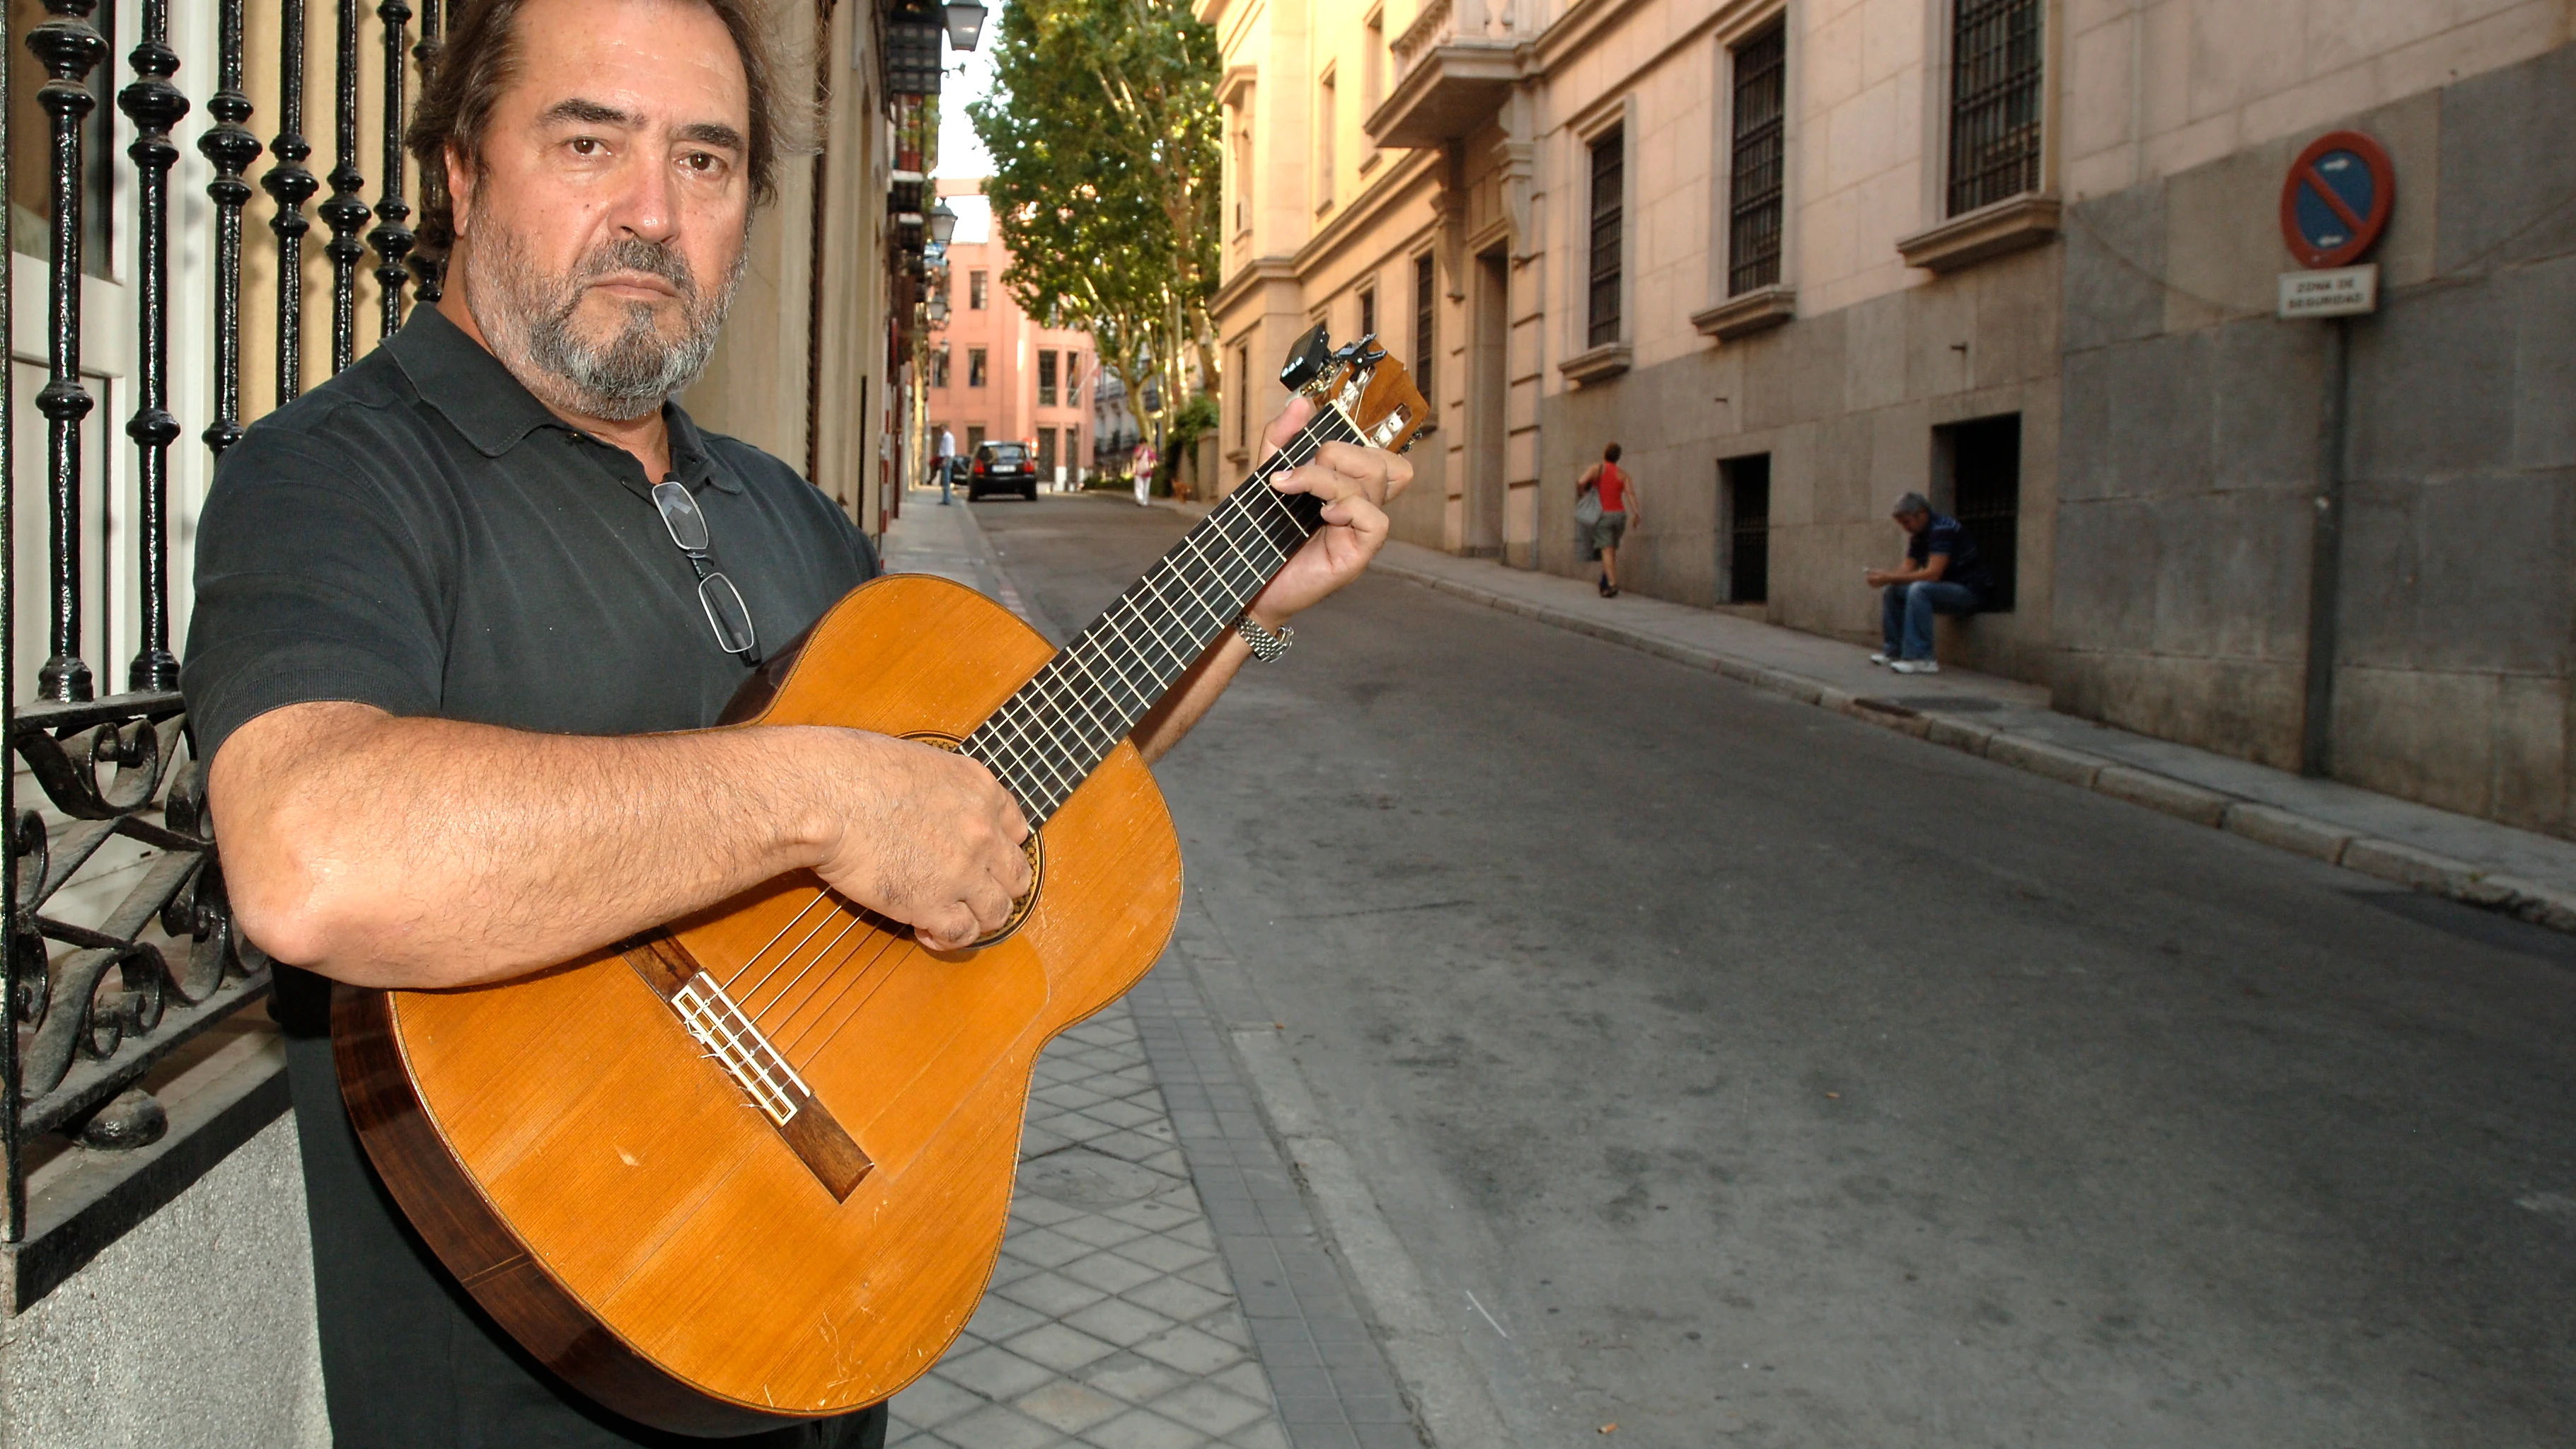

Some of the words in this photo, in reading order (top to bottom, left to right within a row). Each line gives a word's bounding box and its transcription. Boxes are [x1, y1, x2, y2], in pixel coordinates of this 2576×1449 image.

[2297, 282, 2331, 293] ZONA
[2338, 278, 2354, 289] DE
[2288, 293, 2363, 308] SEGURIDAD
